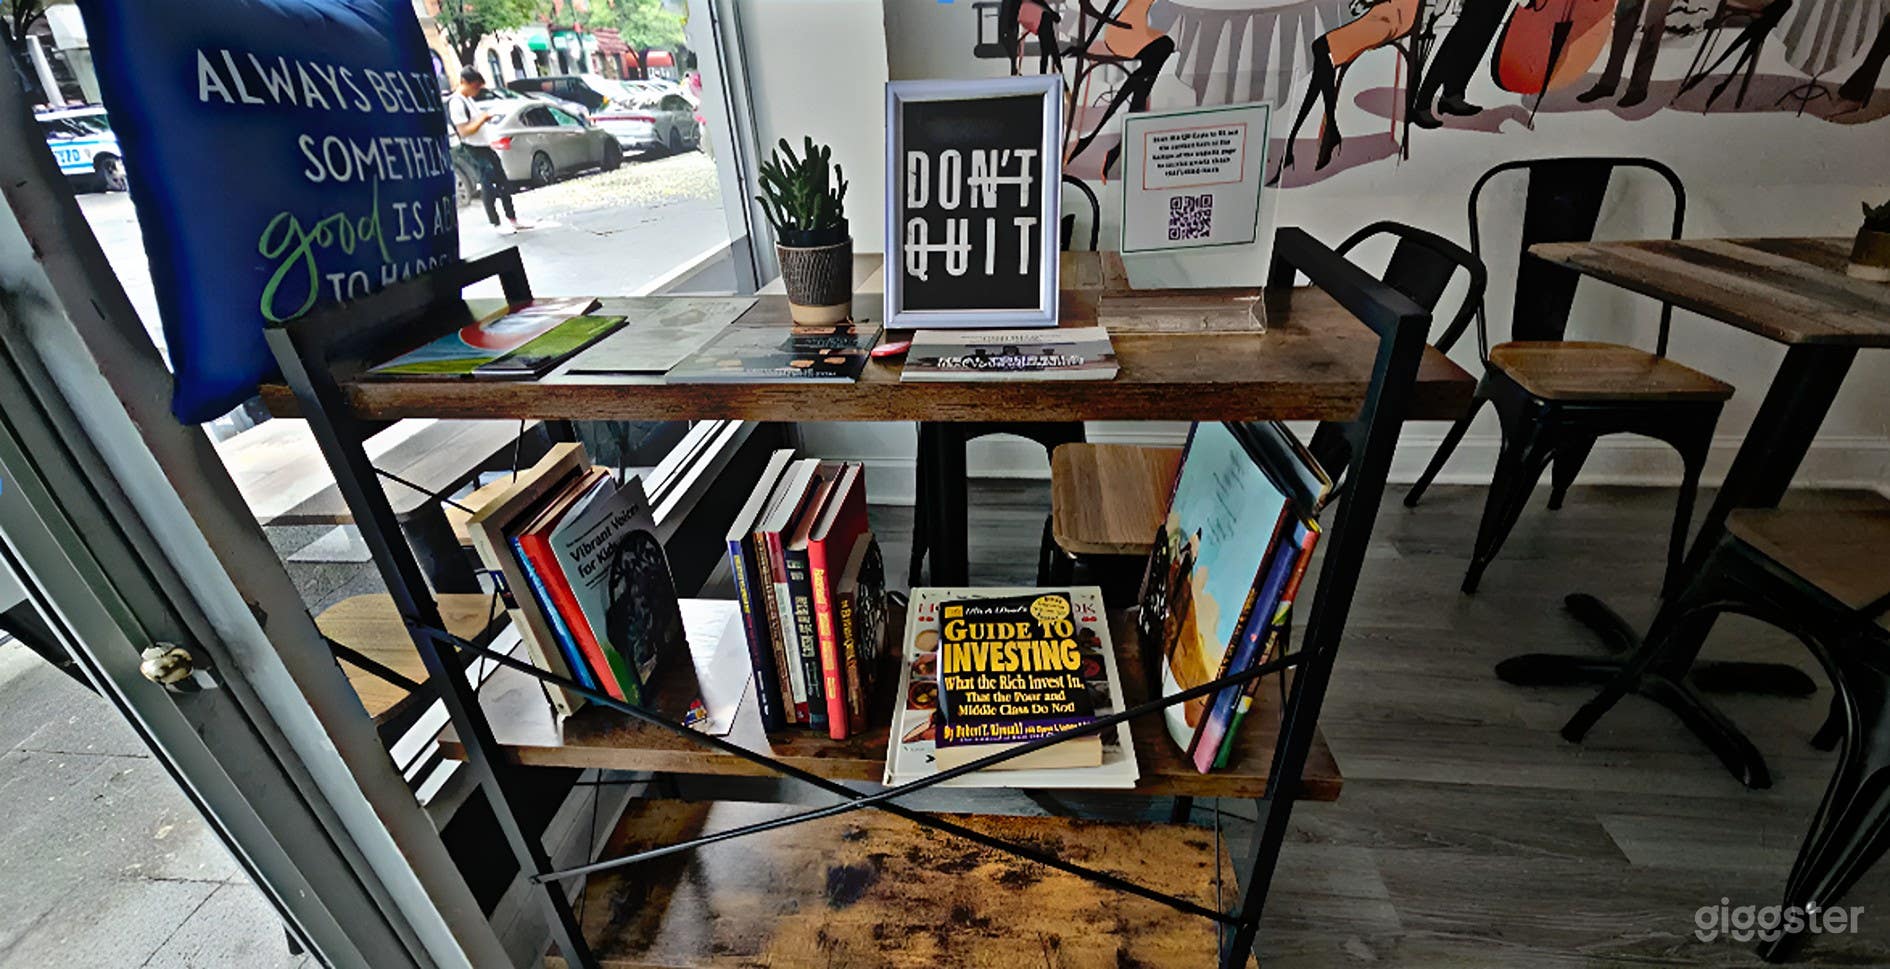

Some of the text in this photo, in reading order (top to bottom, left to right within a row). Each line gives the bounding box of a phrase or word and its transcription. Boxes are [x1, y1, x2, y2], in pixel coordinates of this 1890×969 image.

[197, 48, 372, 113] ALWAYS
[907, 149, 1038, 210] DON'T
[259, 176, 392, 322] good
[392, 201, 425, 242] IS
[904, 217, 1037, 281] QUIT
[326, 270, 370, 304] TO
[569, 526, 613, 562] Vibrant
[577, 555, 599, 579] for
[944, 617, 1074, 642] GUIDE TO
[943, 638, 1082, 674] INVESTING
[944, 673, 1086, 691] What the Rich Invest In,
[965, 691, 991, 703] That
[993, 690, 1011, 703] the
[1044, 690, 1066, 701] and
[957, 703, 997, 717] Middle
[999, 704, 1029, 716] Class
[1031, 702, 1049, 714] Do
